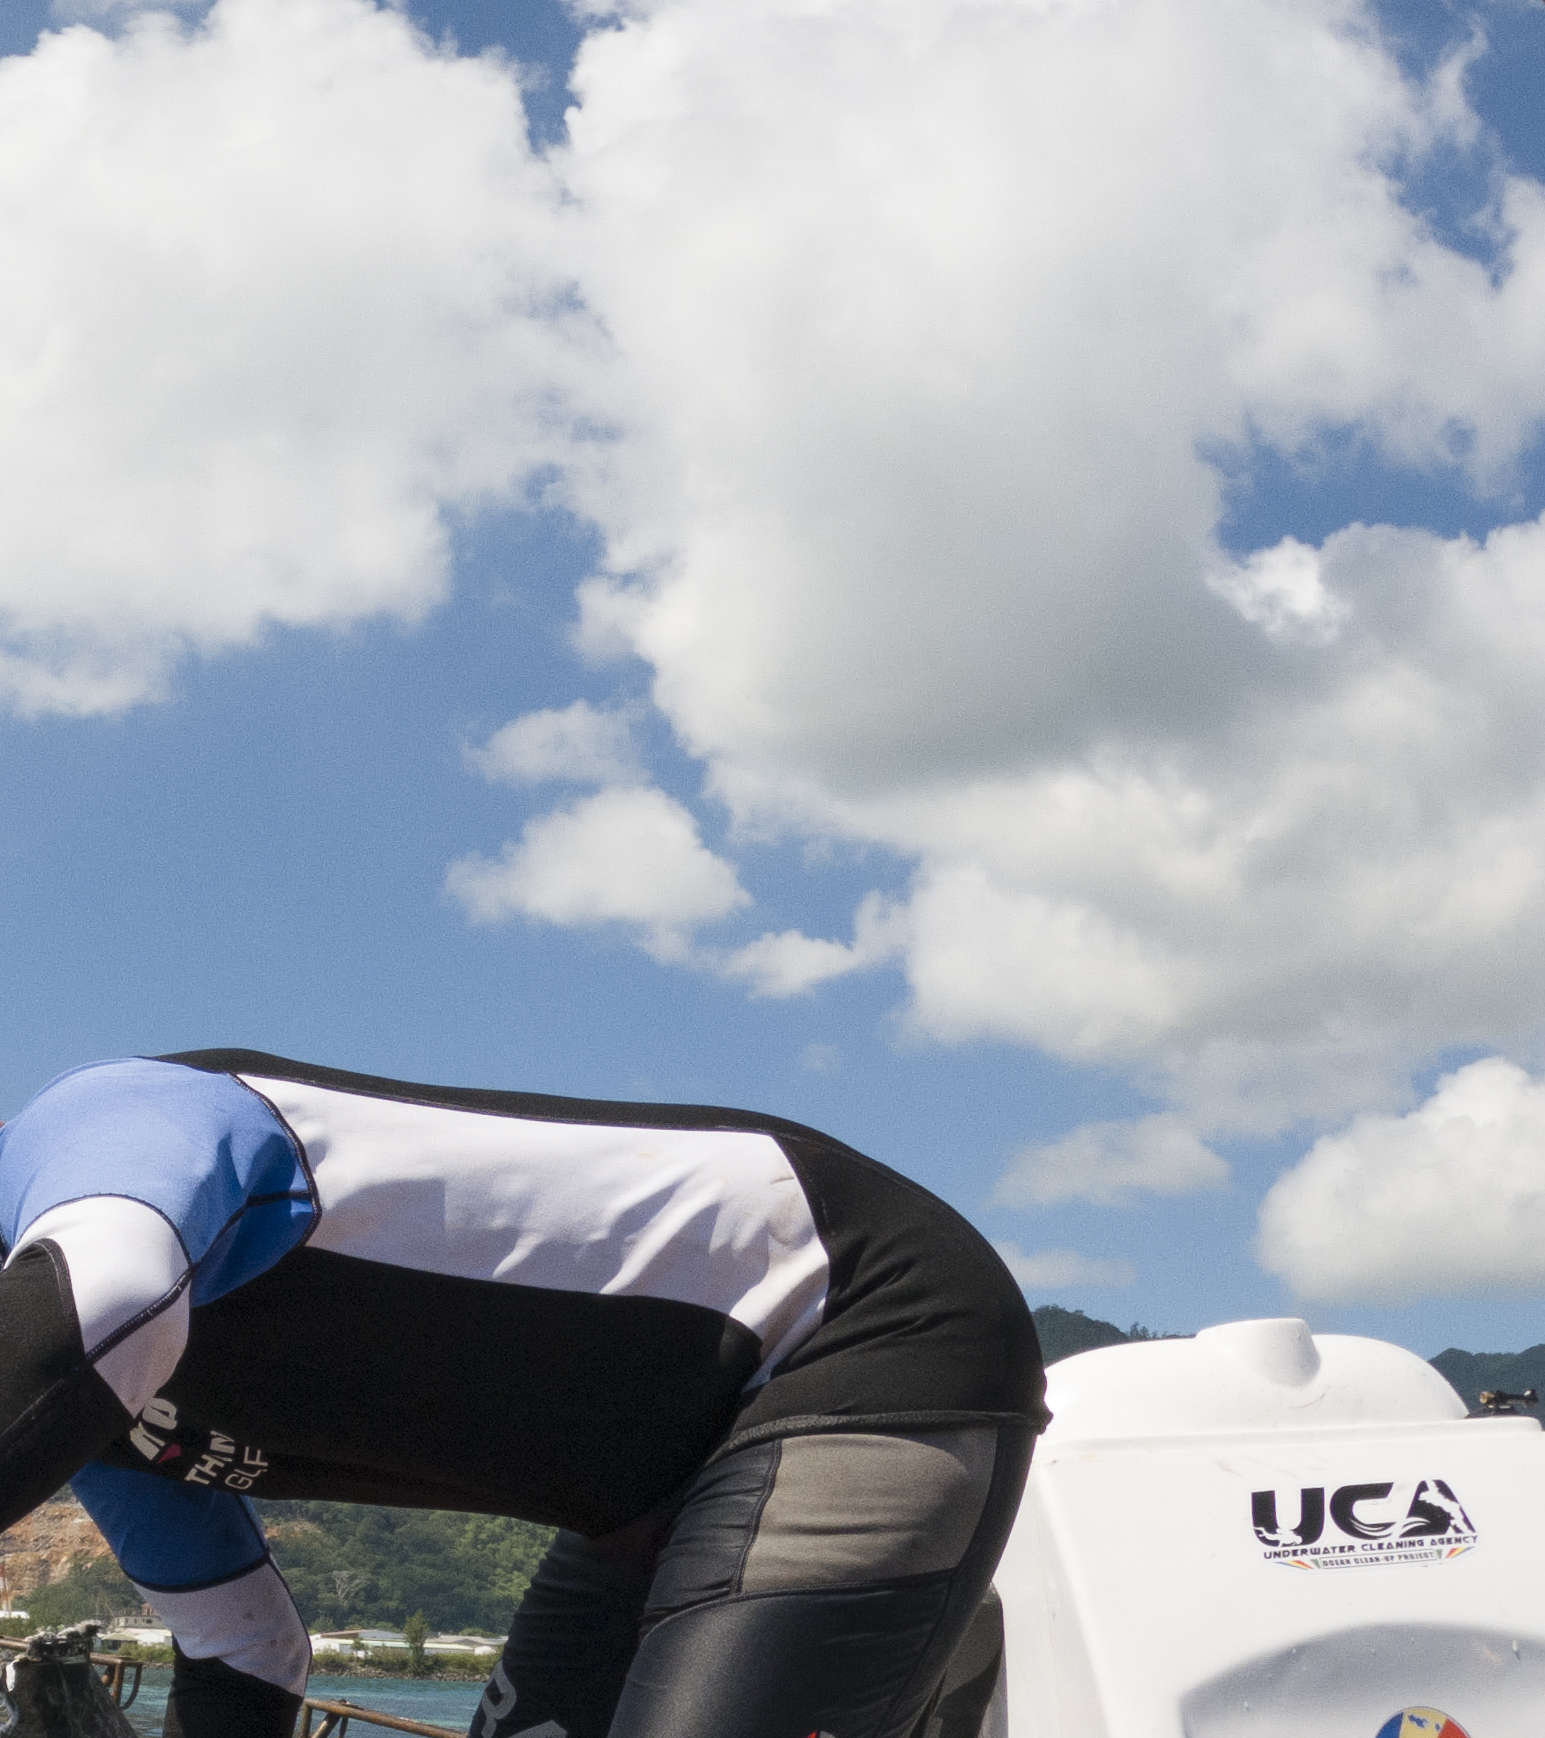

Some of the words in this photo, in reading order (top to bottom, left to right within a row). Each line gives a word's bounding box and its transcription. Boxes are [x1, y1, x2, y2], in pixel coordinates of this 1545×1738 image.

[1251, 1479, 1477, 1547] UCA
[1263, 1544, 1356, 1560] UNDERWATER
[1361, 1538, 1425, 1552] CLEANING
[1430, 1534, 1479, 1546] AGENCY
[1398, 1551, 1435, 1562] PROJECT
